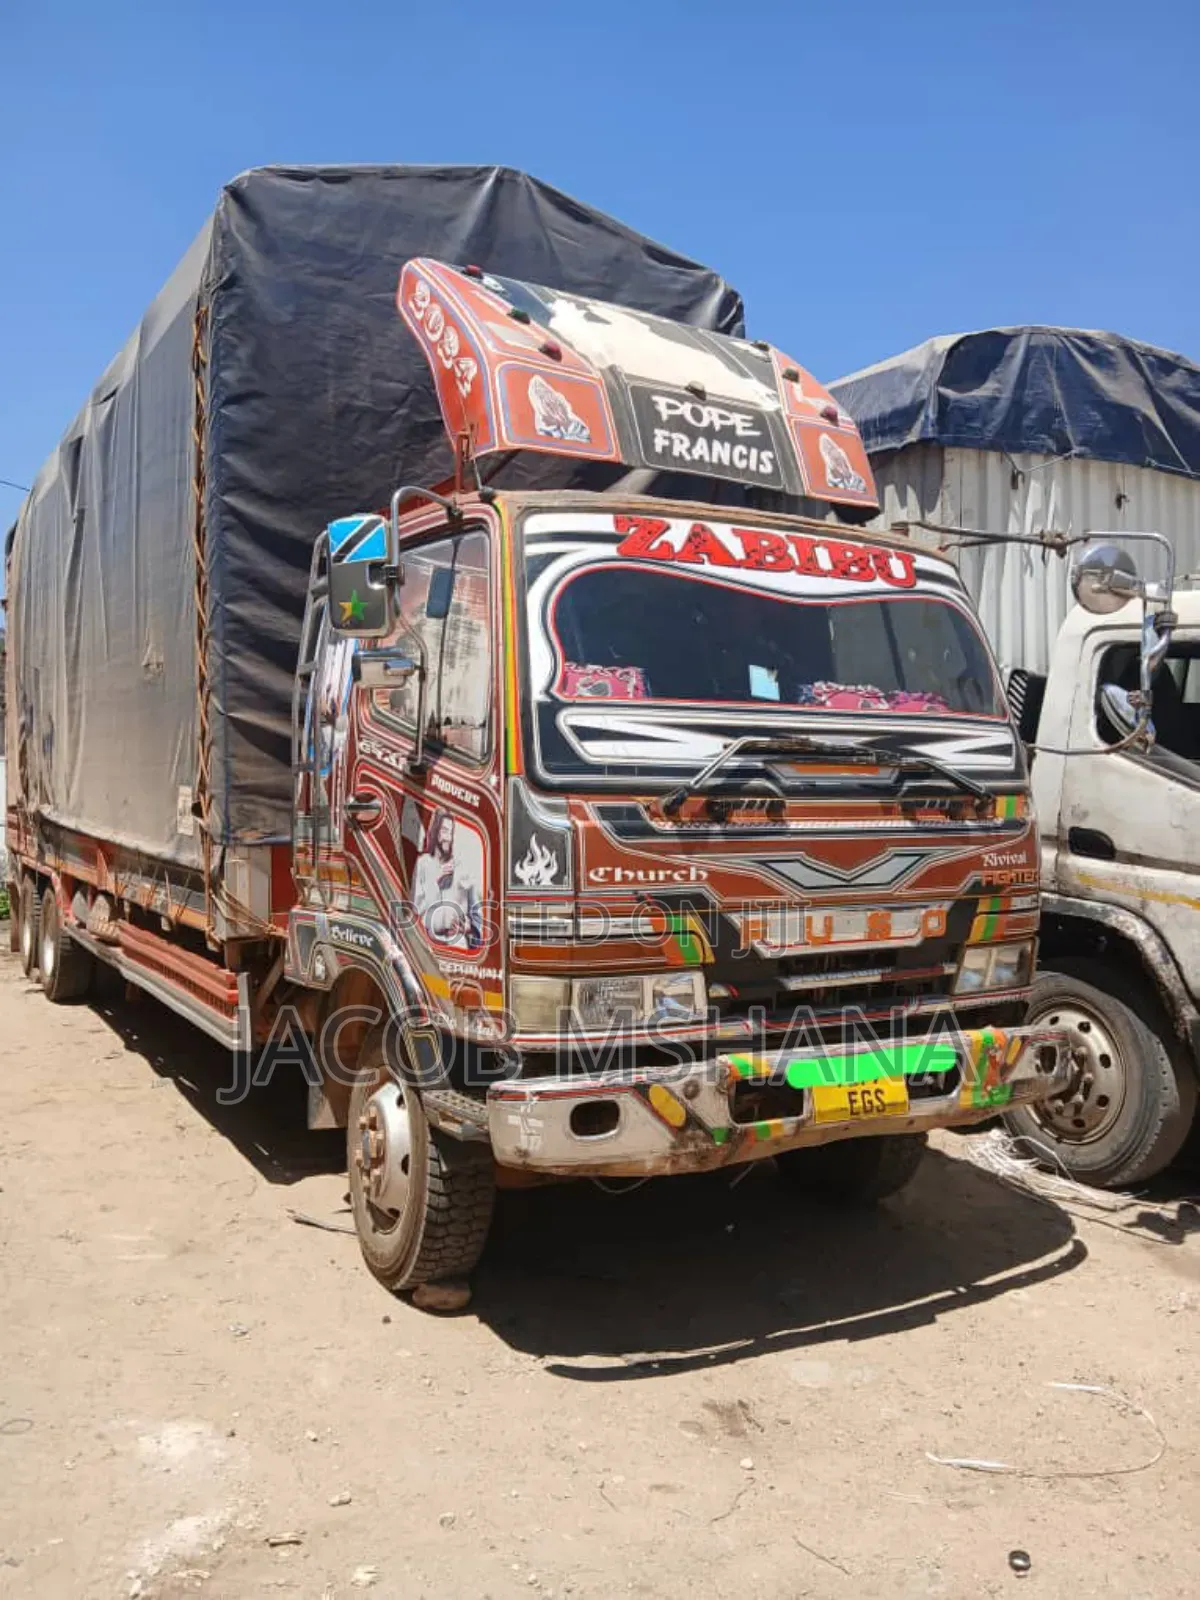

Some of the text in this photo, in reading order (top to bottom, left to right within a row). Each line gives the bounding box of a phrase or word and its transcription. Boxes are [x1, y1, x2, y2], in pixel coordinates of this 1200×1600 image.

[651, 395, 762, 437] POPE
[653, 428, 775, 475] FRANCIS
[612, 514, 918, 589] ZABIBU
[589, 866, 709, 882] Church
[331, 925, 374, 947] Believe
[847, 1088, 886, 1115] EGS
